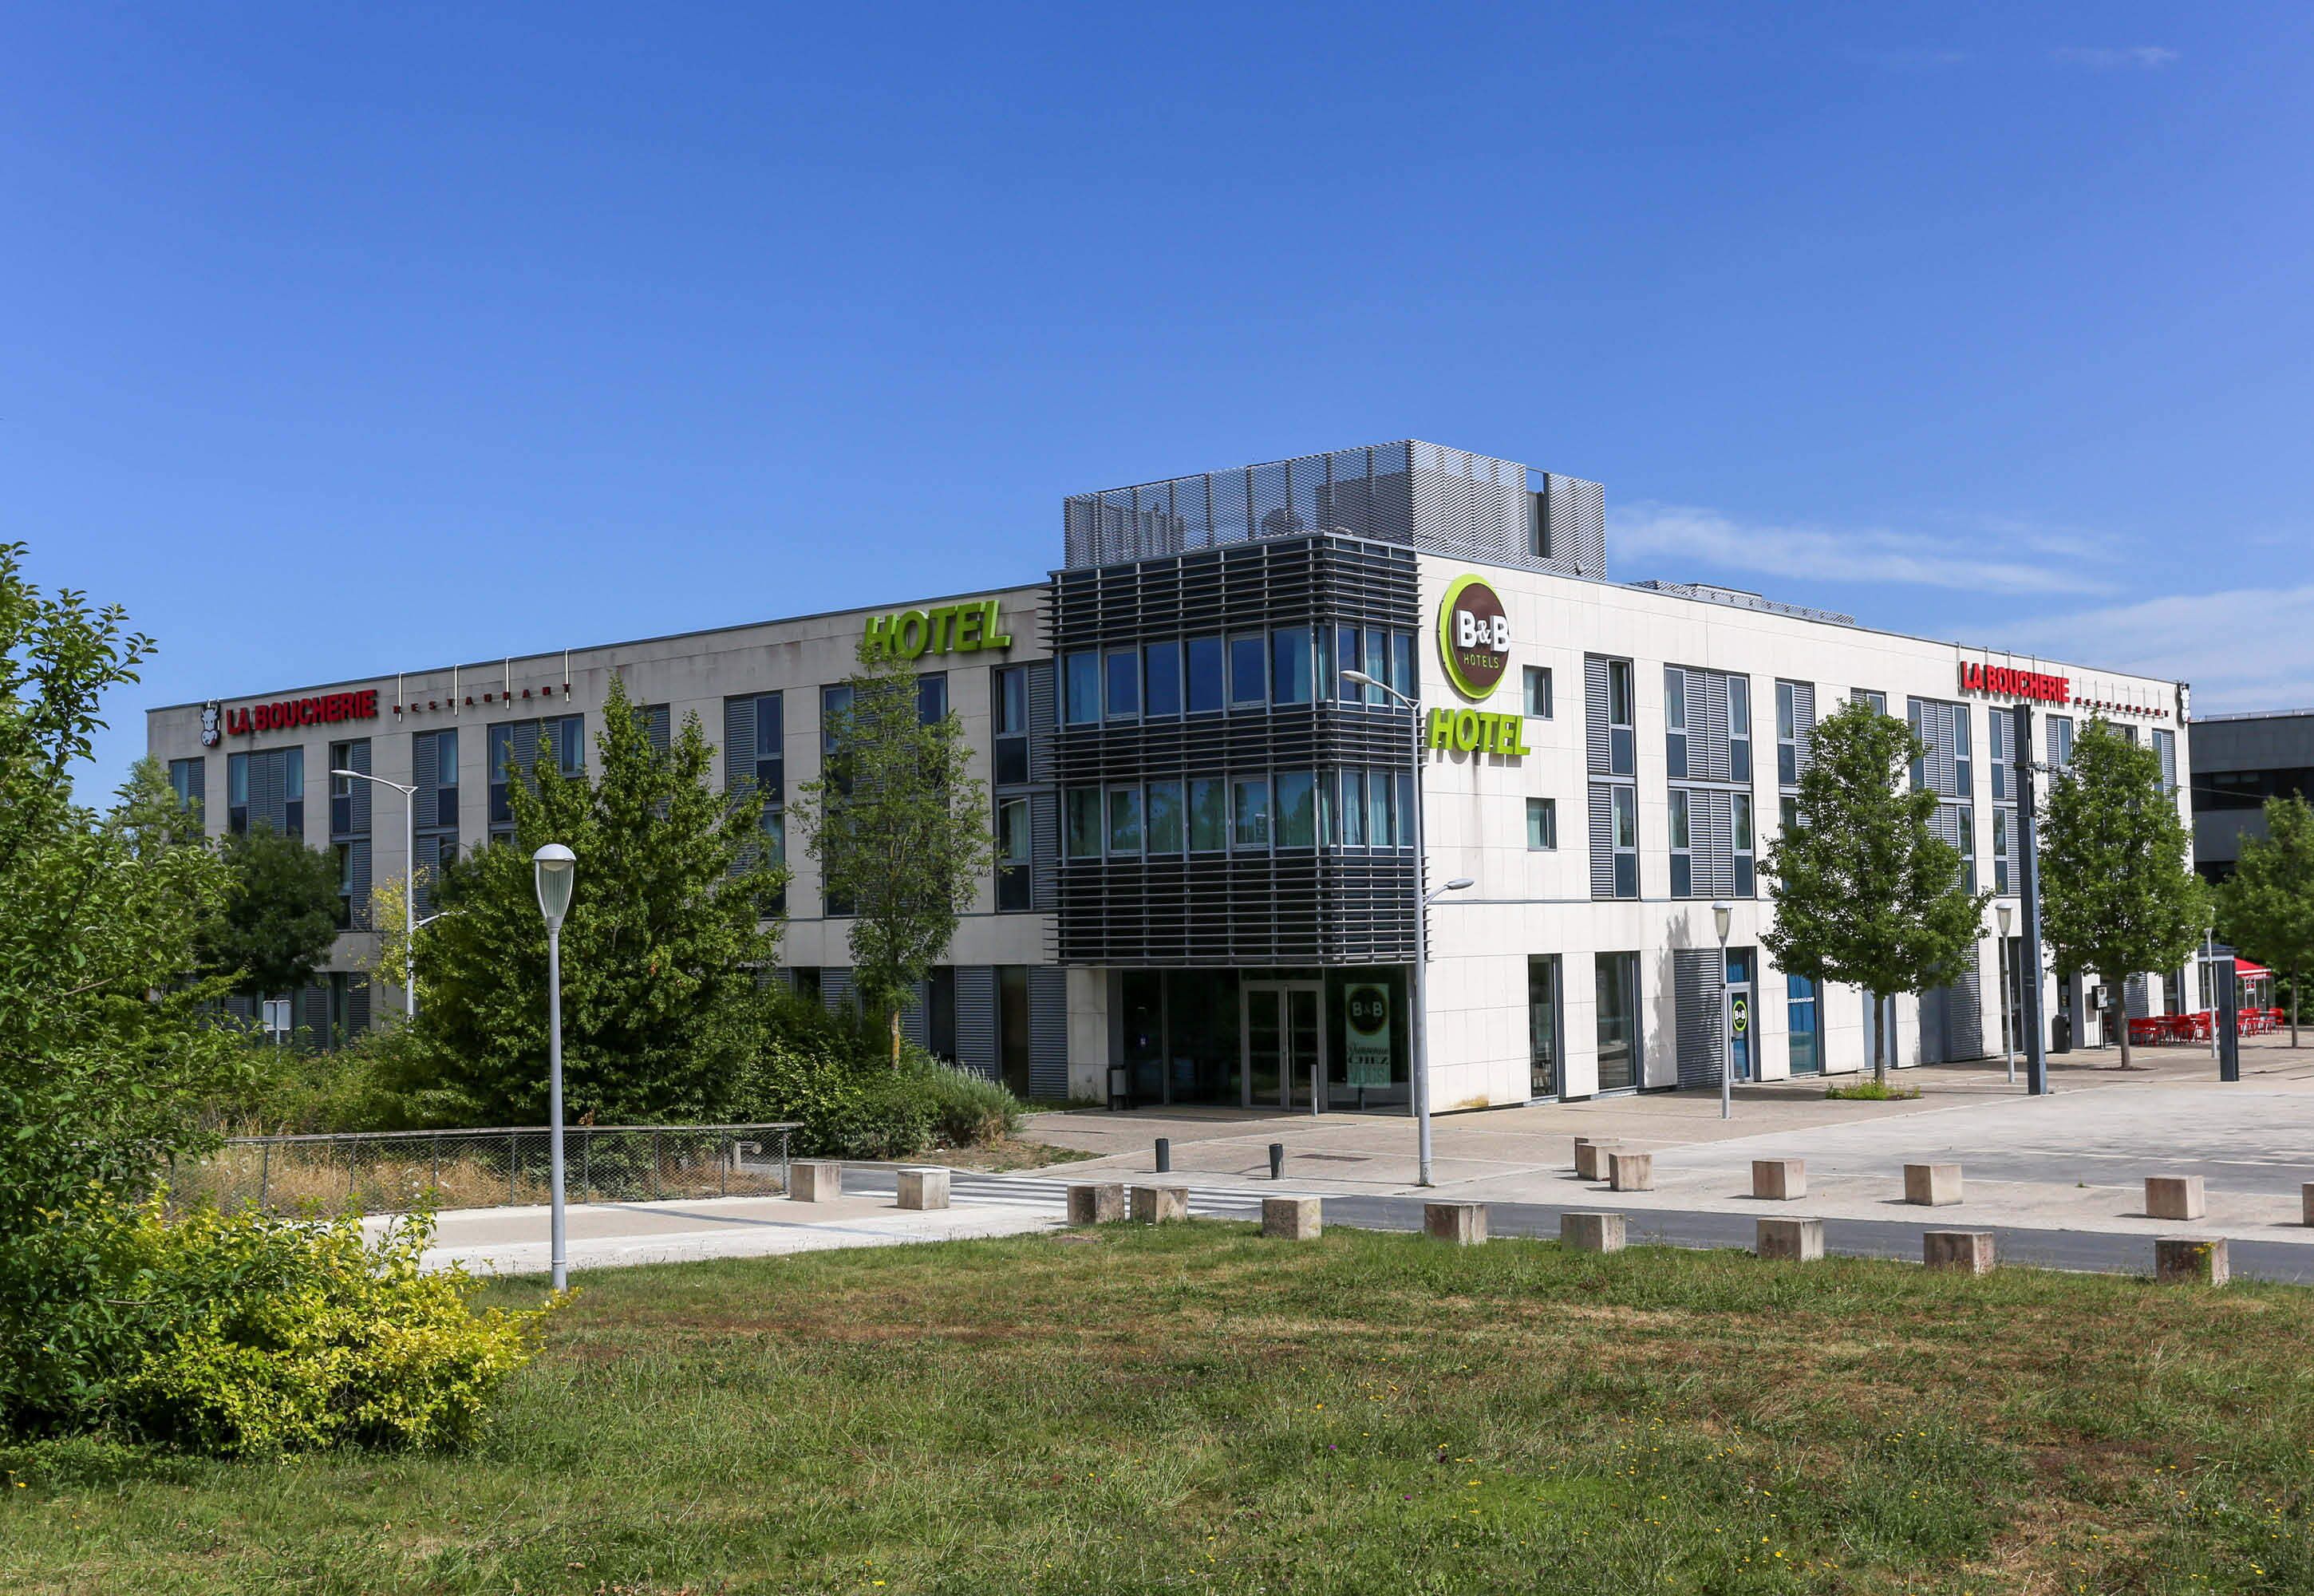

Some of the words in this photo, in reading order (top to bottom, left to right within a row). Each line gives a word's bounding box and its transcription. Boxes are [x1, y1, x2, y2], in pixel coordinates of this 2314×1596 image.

[863, 599, 1012, 661] HOTEL
[1456, 610, 1510, 653] B&B
[1463, 653, 1499, 669] HOTELS
[1960, 661, 1984, 690] LA
[1984, 665, 2071, 703] BOUCHERIE
[227, 707, 250, 736] LA
[255, 689, 378, 731] BOUCHERIE
[1430, 707, 1531, 756] HOTEL
[1352, 1001, 1384, 1017] B&B
